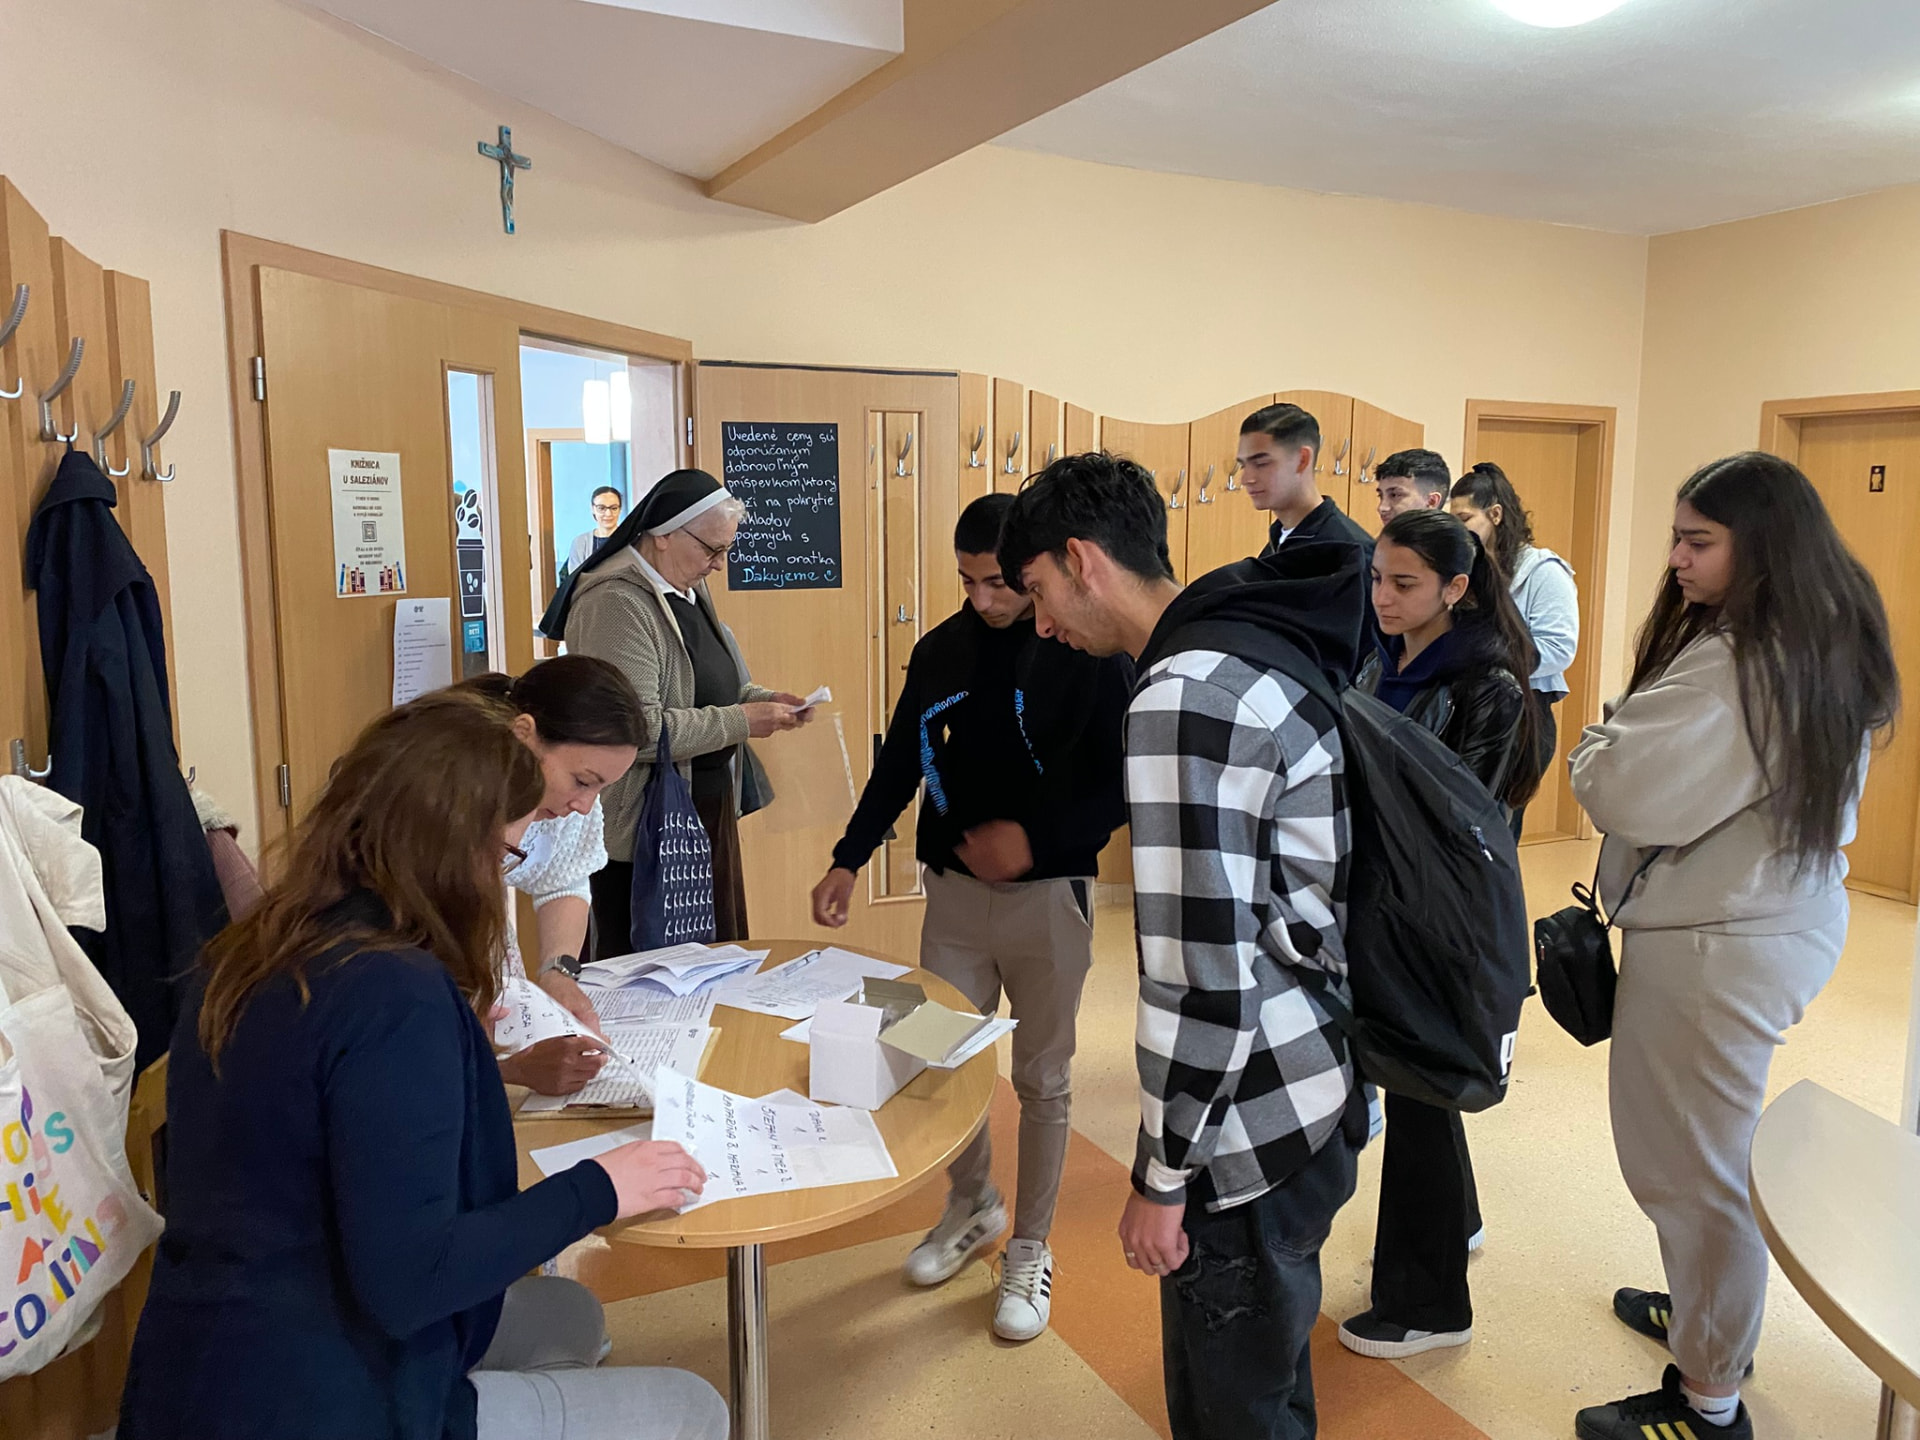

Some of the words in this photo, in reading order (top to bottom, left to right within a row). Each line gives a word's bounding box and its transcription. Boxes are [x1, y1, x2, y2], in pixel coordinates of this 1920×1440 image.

[727, 424, 778, 441] Uvedené
[786, 432, 813, 447] ceny
[819, 428, 835, 443] sú
[727, 441, 811, 461] odporúčaným
[350, 457, 380, 469] KNIŽNICA
[725, 458, 809, 477] dobrovoľným
[342, 475, 348, 484] U
[350, 473, 389, 486] SALEZIÁNOV
[765, 498, 781, 507] na
[786, 492, 834, 514] pokrytie
[801, 532, 810, 543] s
[742, 565, 819, 588] Ďakujeme
